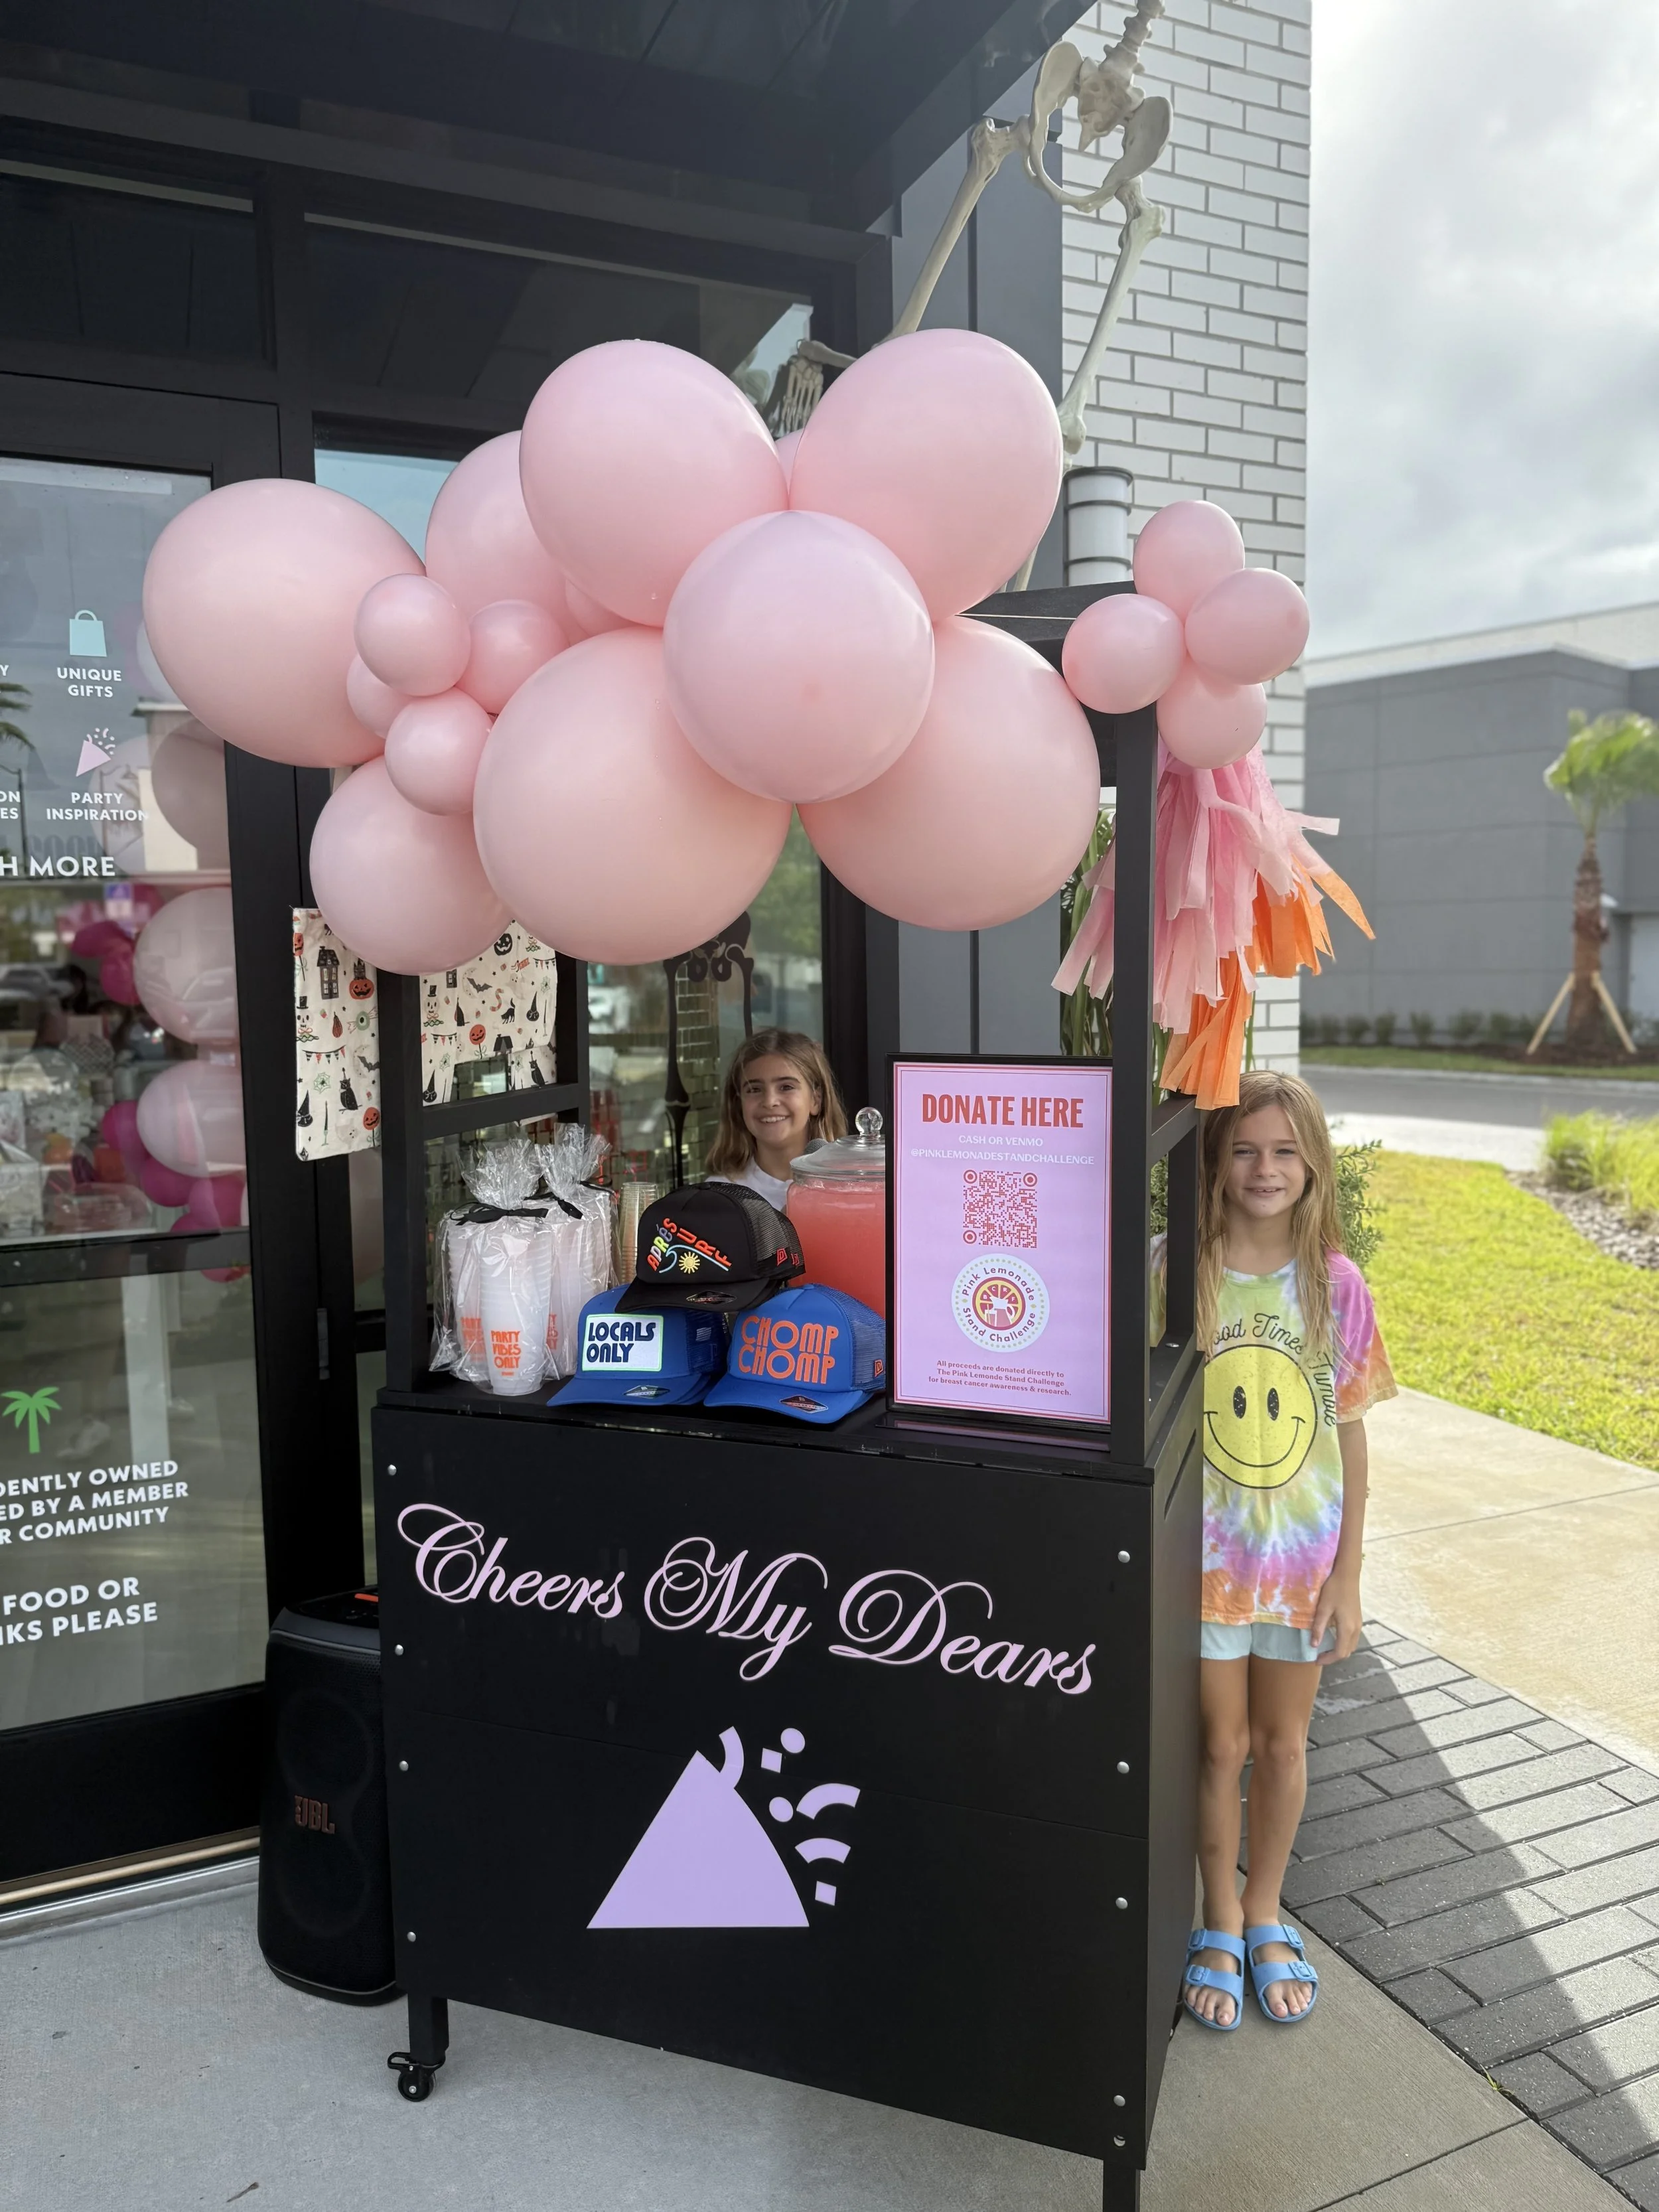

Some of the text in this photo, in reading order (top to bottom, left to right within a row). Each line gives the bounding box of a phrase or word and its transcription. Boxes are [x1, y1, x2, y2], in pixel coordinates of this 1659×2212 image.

[57, 667, 122, 682] UNIQUE
[68, 684, 113, 698] GIFTS
[71, 792, 123, 804] PARTY
[46, 808, 149, 821] INSPIRATION
[29, 855, 115, 877] MORE
[922, 1093, 1084, 1128] DONATE HERE
[958, 1135, 1043, 1147] CASH OR VENMO
[910, 1147, 1094, 1165] @PINKLEMONADESTANDCHALLENGE
[962, 1267, 1035, 1301] Pink Lemonade
[588, 1321, 656, 1342] LOCALS
[741, 1315, 839, 1355] CHOMP
[963, 1307, 1035, 1343] Stand Challenge
[490, 1330, 521, 1343] PARTY
[492, 1343, 522, 1356] VIBES
[587, 1343, 634, 1363] ONLY
[493, 1356, 521, 1368] ONLY
[738, 1345, 835, 1384] CHOMP
[948, 1361, 981, 1370] proceeds
[995, 1364, 1025, 1374] donated
[1027, 1368, 1054, 1378] directly
[940, 1376, 963, 1385] breast
[989, 1382, 1028, 1392] awareness
[1037, 1387, 1072, 1396] research.
[970, 1372, 1003, 1381] Lemonde
[1004, 1374, 1026, 1383] Stand
[1027, 1377, 1064, 1388] Challenge
[88, 1460, 179, 1485] OWNED
[32, 1497, 61, 1517] BY
[68, 1495, 86, 1512] A
[92, 1481, 189, 1509] MEMBER
[19, 1506, 169, 1542] COMMUNITY
[3, 1576, 140, 1616] FOOD OR
[398, 1503, 1096, 1695] Cheers My Dears
[52, 1601, 158, 1637] PLEASE
[295, 1795, 335, 1834] JBL
